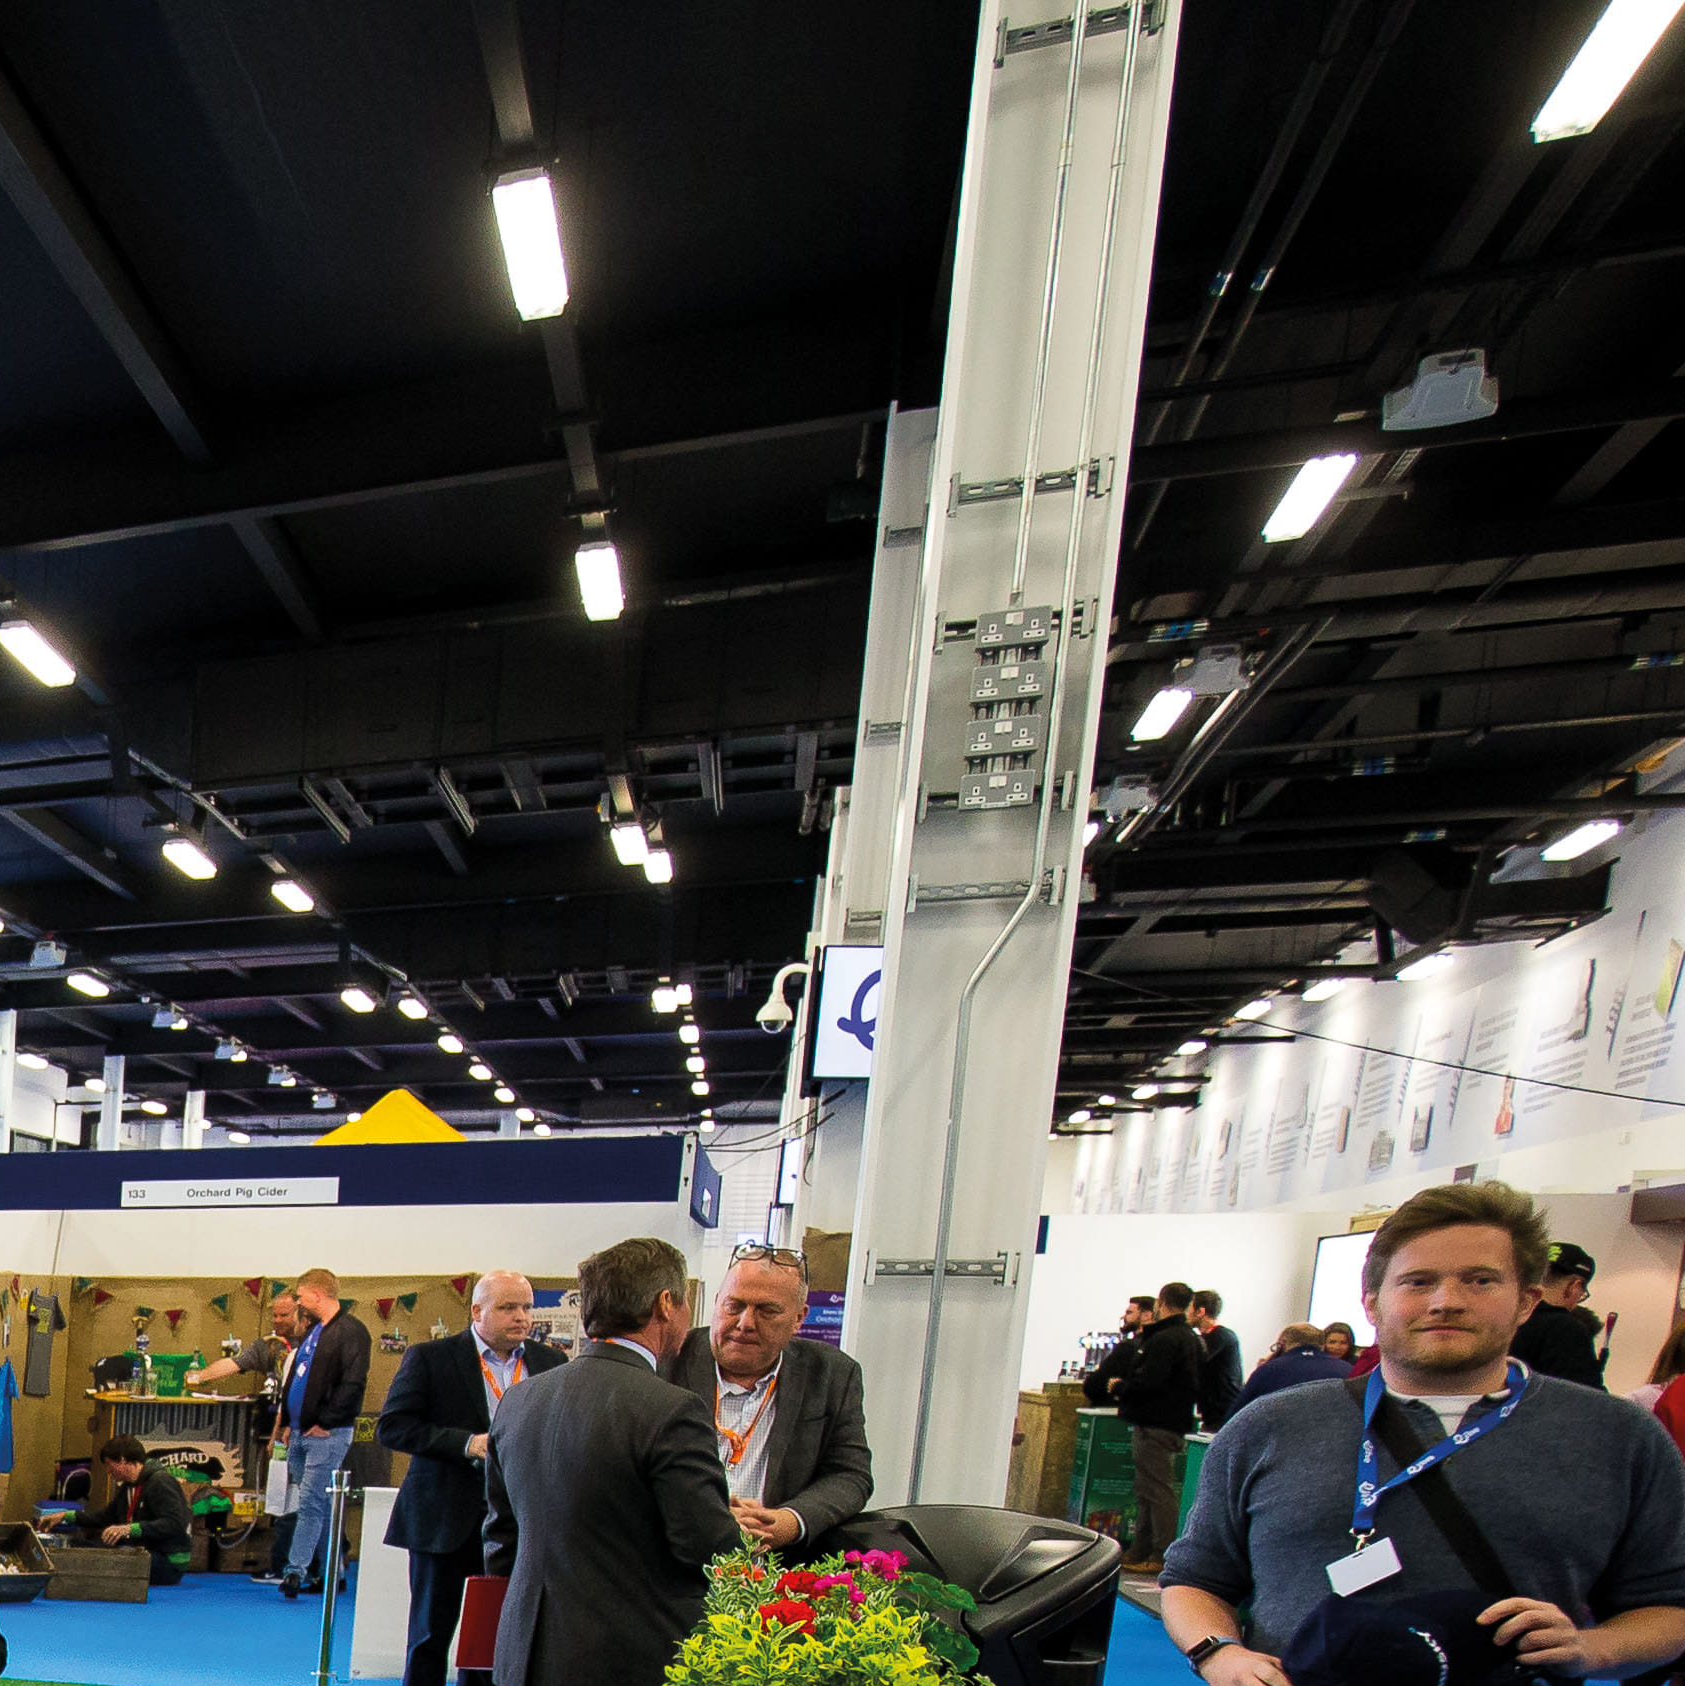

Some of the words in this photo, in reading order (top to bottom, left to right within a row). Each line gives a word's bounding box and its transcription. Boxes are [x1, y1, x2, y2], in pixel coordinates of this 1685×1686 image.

[128, 1189, 146, 1199] 133
[186, 1187, 231, 1198] Orchard
[235, 1187, 253, 1199] Pig
[257, 1186, 288, 1197] Cider
